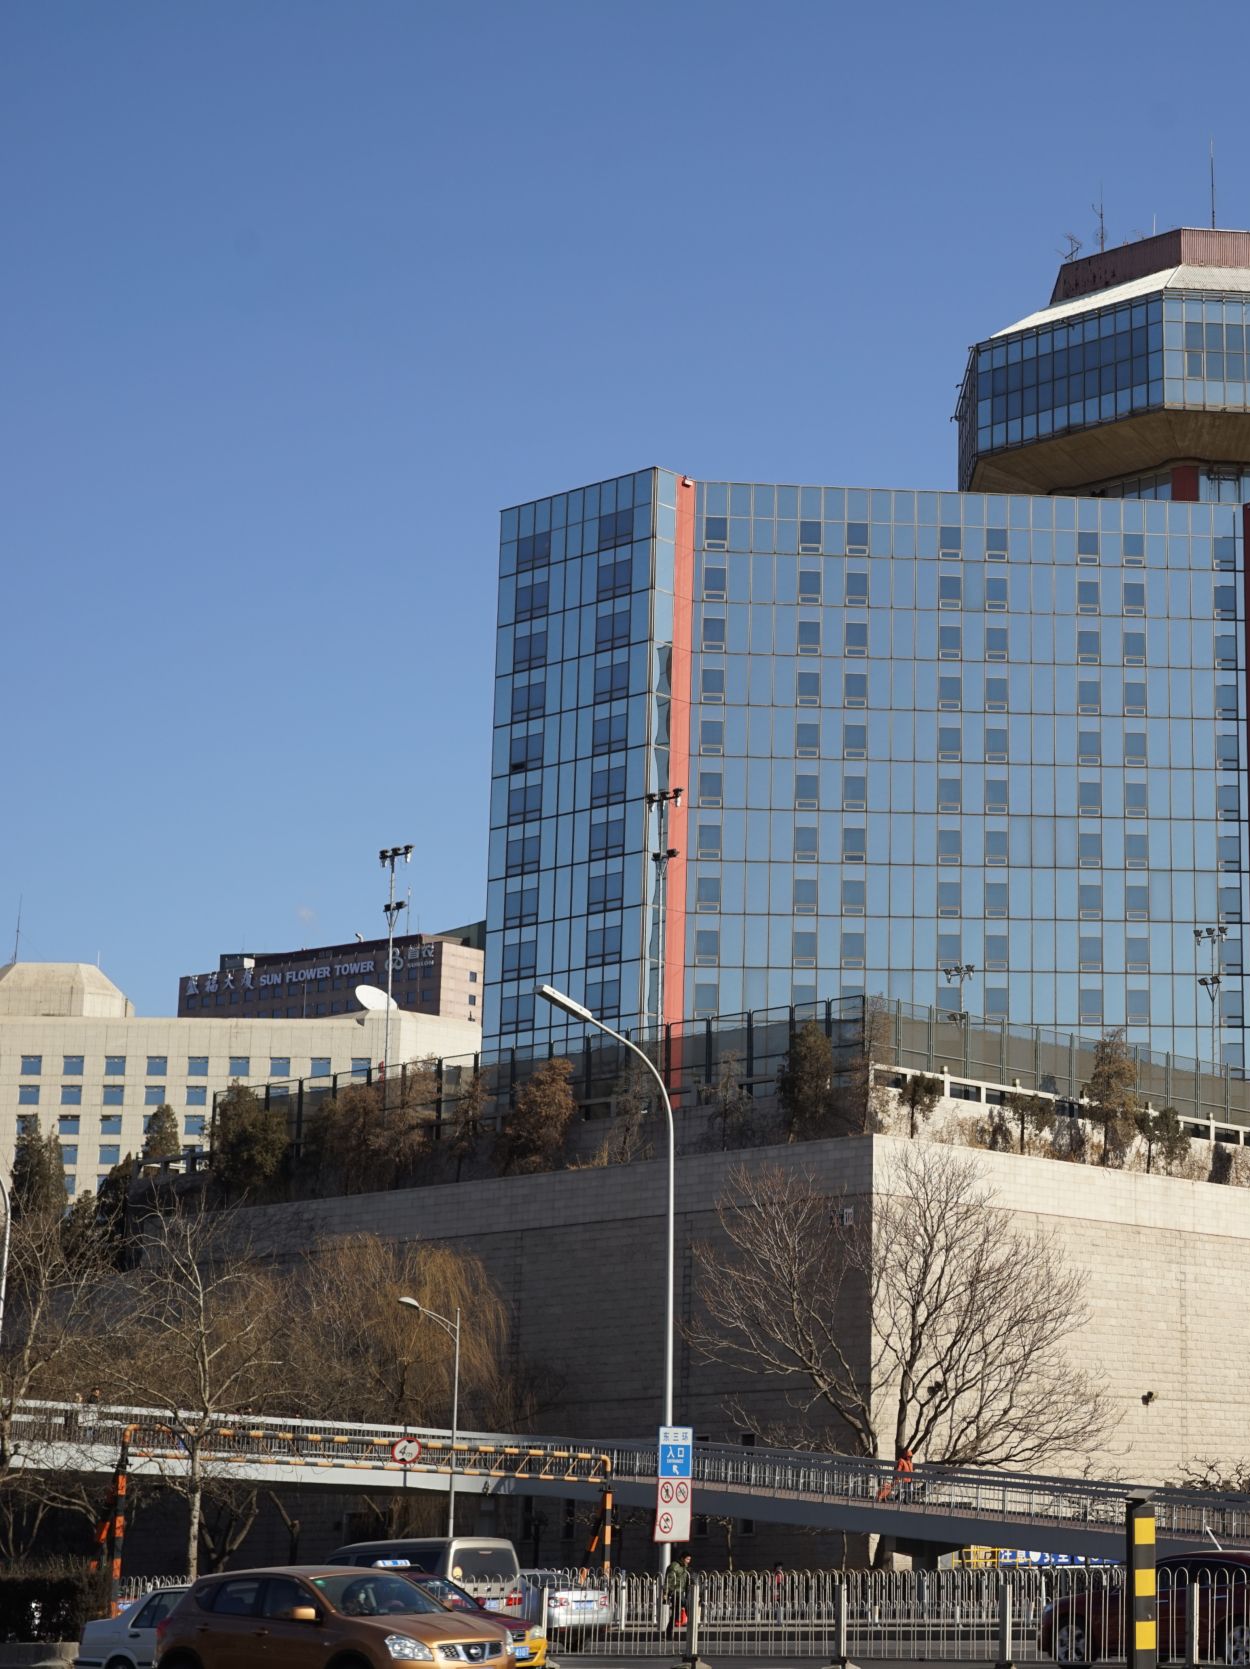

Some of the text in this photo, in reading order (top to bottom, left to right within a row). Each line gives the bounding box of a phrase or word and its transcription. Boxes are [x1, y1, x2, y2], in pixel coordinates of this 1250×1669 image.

[259, 959, 375, 987] SUN FLOWER TOWER
[666, 1446, 684, 1458] 入口
